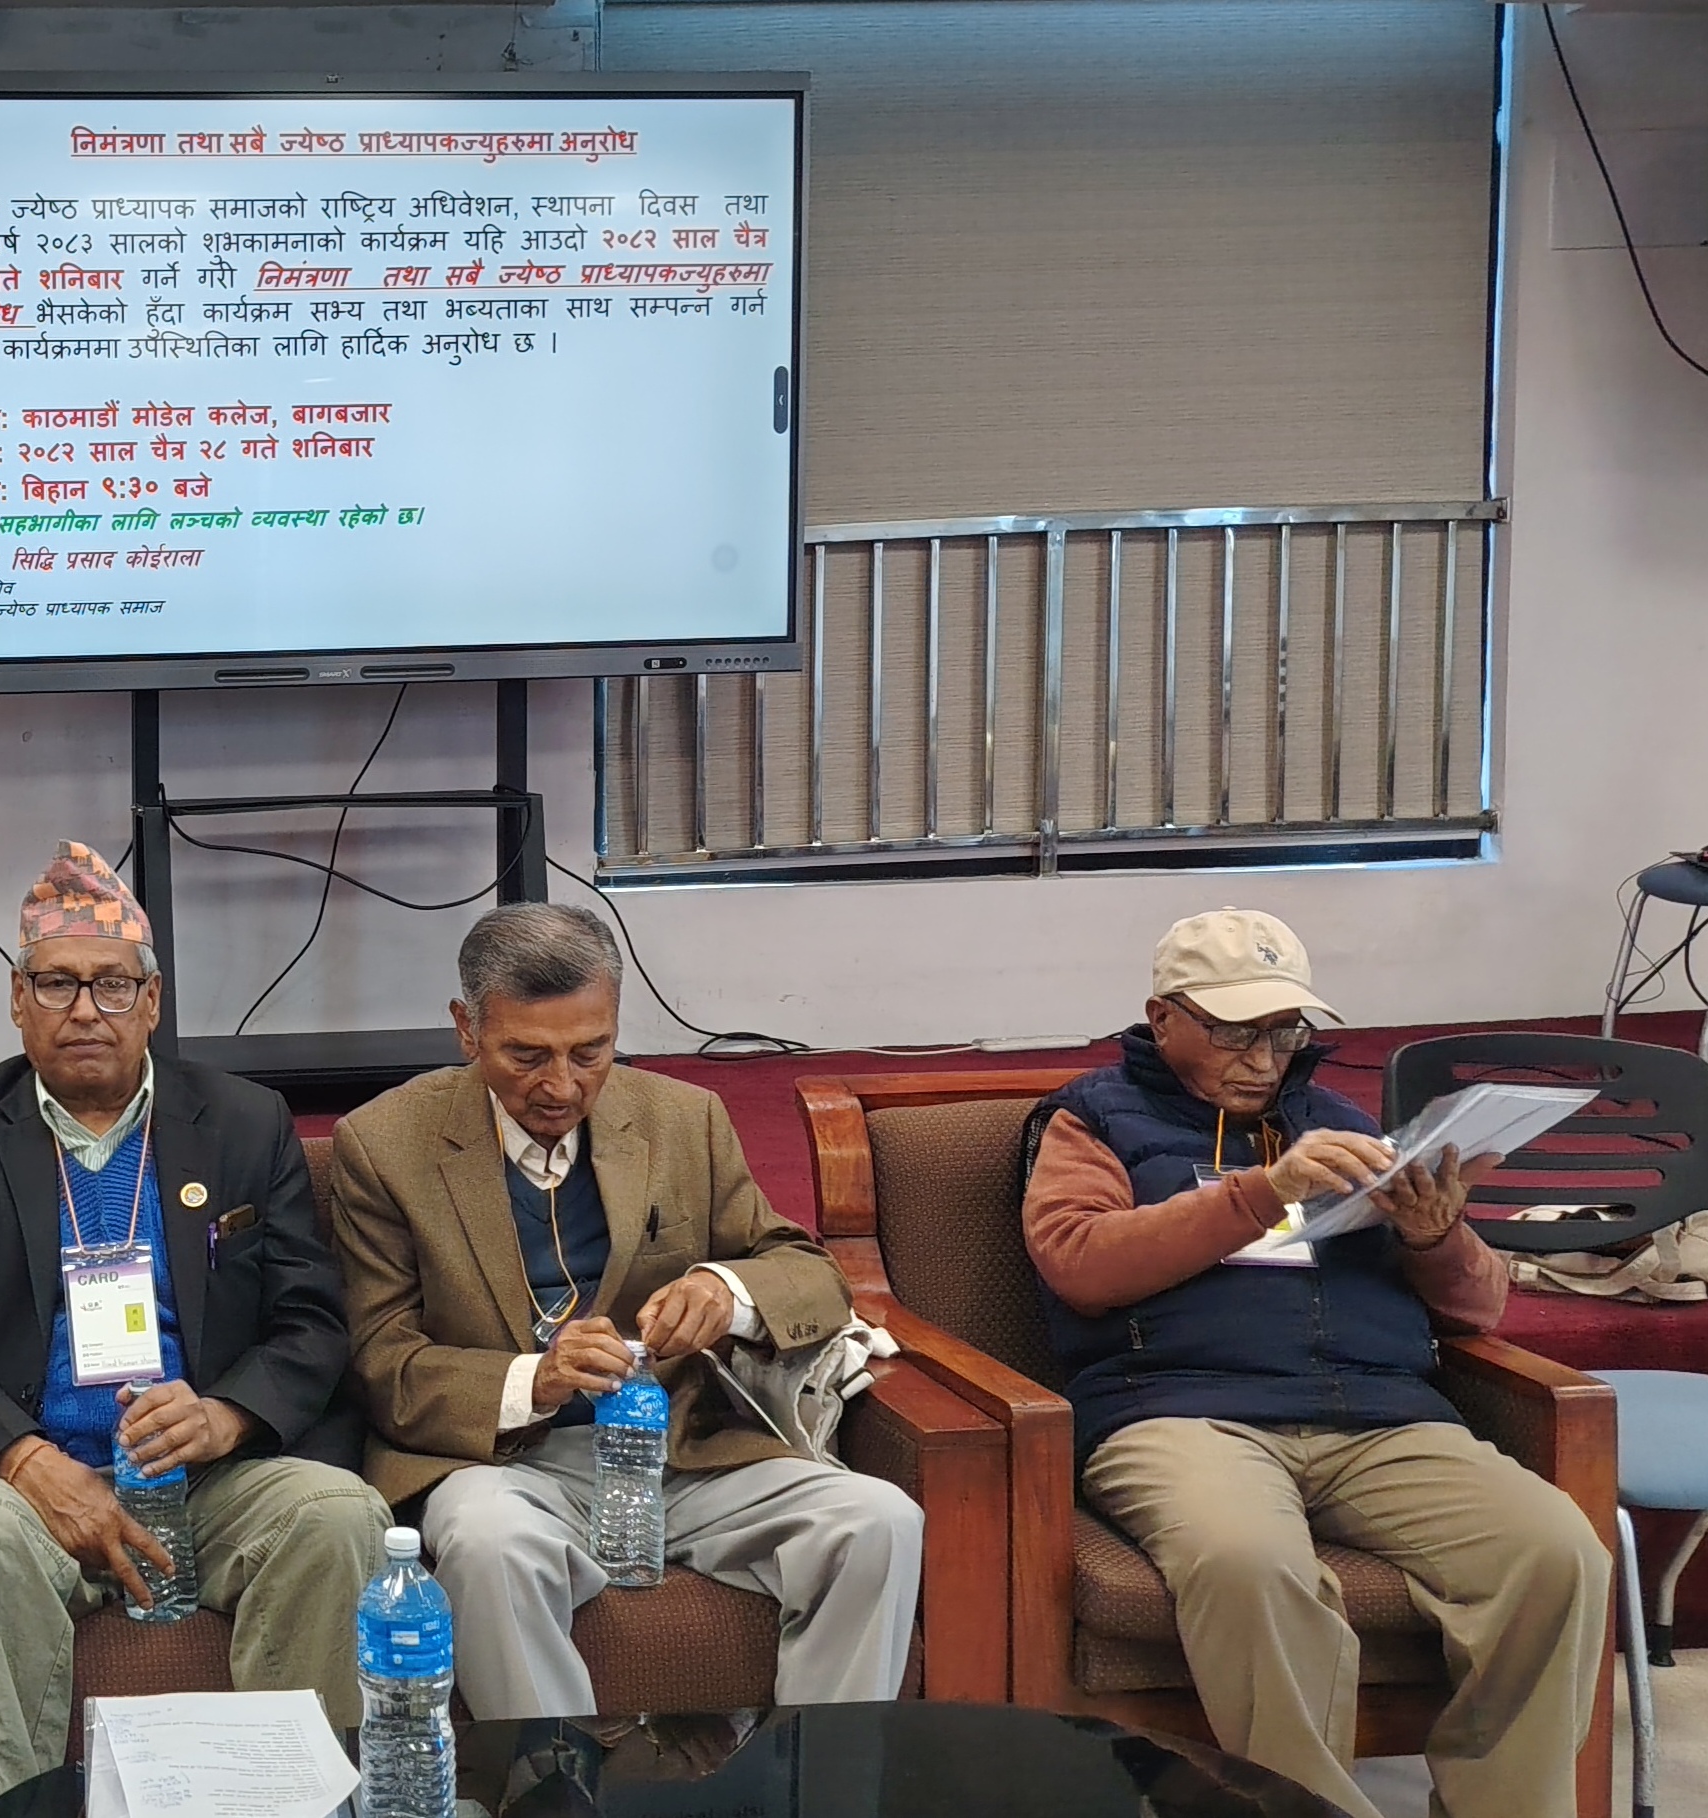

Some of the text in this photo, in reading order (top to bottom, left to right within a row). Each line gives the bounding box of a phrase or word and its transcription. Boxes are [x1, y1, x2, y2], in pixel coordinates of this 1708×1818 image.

[71, 125, 166, 154] निमंत्रणा
[178, 133, 222, 154] तथा
[229, 124, 267, 154] सबै
[279, 127, 346, 154] ज्येष्ठ
[560, 125, 638, 162] अनुरोध
[10, 193, 79, 219] ज्येष्ठ
[91, 198, 197, 219] प्राध्यापक
[209, 192, 308, 219] समाजको
[320, 191, 397, 223] राष्ट्रिय
[409, 190, 518, 220] अधिवेशन,
[530, 197, 615, 217] स्थापना
[639, 189, 699, 217] दिवस
[724, 195, 769, 215] तथा
[37, 234, 92, 254] २०८३
[109, 227, 188, 254] सालको
[203, 226, 346, 263] शुभकामनाको
[361, 224, 449, 252] कार्यक्रम
[465, 224, 506, 252] यहि
[521, 223, 588, 251] आउदो
[602, 229, 657, 250] २०८२
[673, 229, 720, 250] साल
[734, 221, 770, 249] चैत्र
[40, 262, 124, 290] शनिबार
[141, 262, 180, 288] गर्ने
[257, 260, 353, 287] निमंत्रणा
[384, 266, 432, 287] तथा
[446, 258, 485, 287] सबै
[499, 260, 566, 284] ज्येष्ठ
[37, 297, 128, 325] भैसकेको
[203, 296, 293, 323] कार्यक्रम
[310, 301, 366, 322] सभ्य
[382, 301, 428, 321] तथा
[446, 299, 549, 319] भब्यताका
[566, 298, 613, 319] साथ
[629, 297, 713, 318] सम्पन्न
[730, 288, 768, 315] गर्न
[2, 331, 121, 359] कार्यक्रममा
[272, 329, 329, 356] लागि
[340, 328, 410, 357] हार्दिक
[422, 327, 501, 365] अनुरोध
[513, 333, 536, 352] छ
[22, 399, 120, 428] काठमाडौं
[132, 401, 195, 426] मोडेल
[208, 400, 277, 428] कलेज,
[291, 403, 392, 424] बागबजार
[19, 443, 74, 462] २०८२
[89, 442, 138, 462] साल
[150, 433, 187, 460] चैत्र
[200, 440, 226, 459] २८
[241, 433, 279, 459] गते
[293, 431, 375, 458] शनिबार
[22, 474, 89, 504] बिहान
[103, 477, 158, 498] ९:३०
[173, 471, 212, 497] बजे
[0, 509, 102, 536] सहभागीका
[112, 507, 161, 531] लागि
[252, 509, 330, 528] व्यवस्था
[339, 503, 389, 529] रहेको
[12, 546, 59, 570] सिद्धि
[67, 549, 118, 570] प्रसाद
[126, 544, 206, 568] कोईराला
[46, 602, 114, 616] प्राध्यापक
[120, 601, 166, 615] समाज
[78, 1271, 118, 1286] CARD
